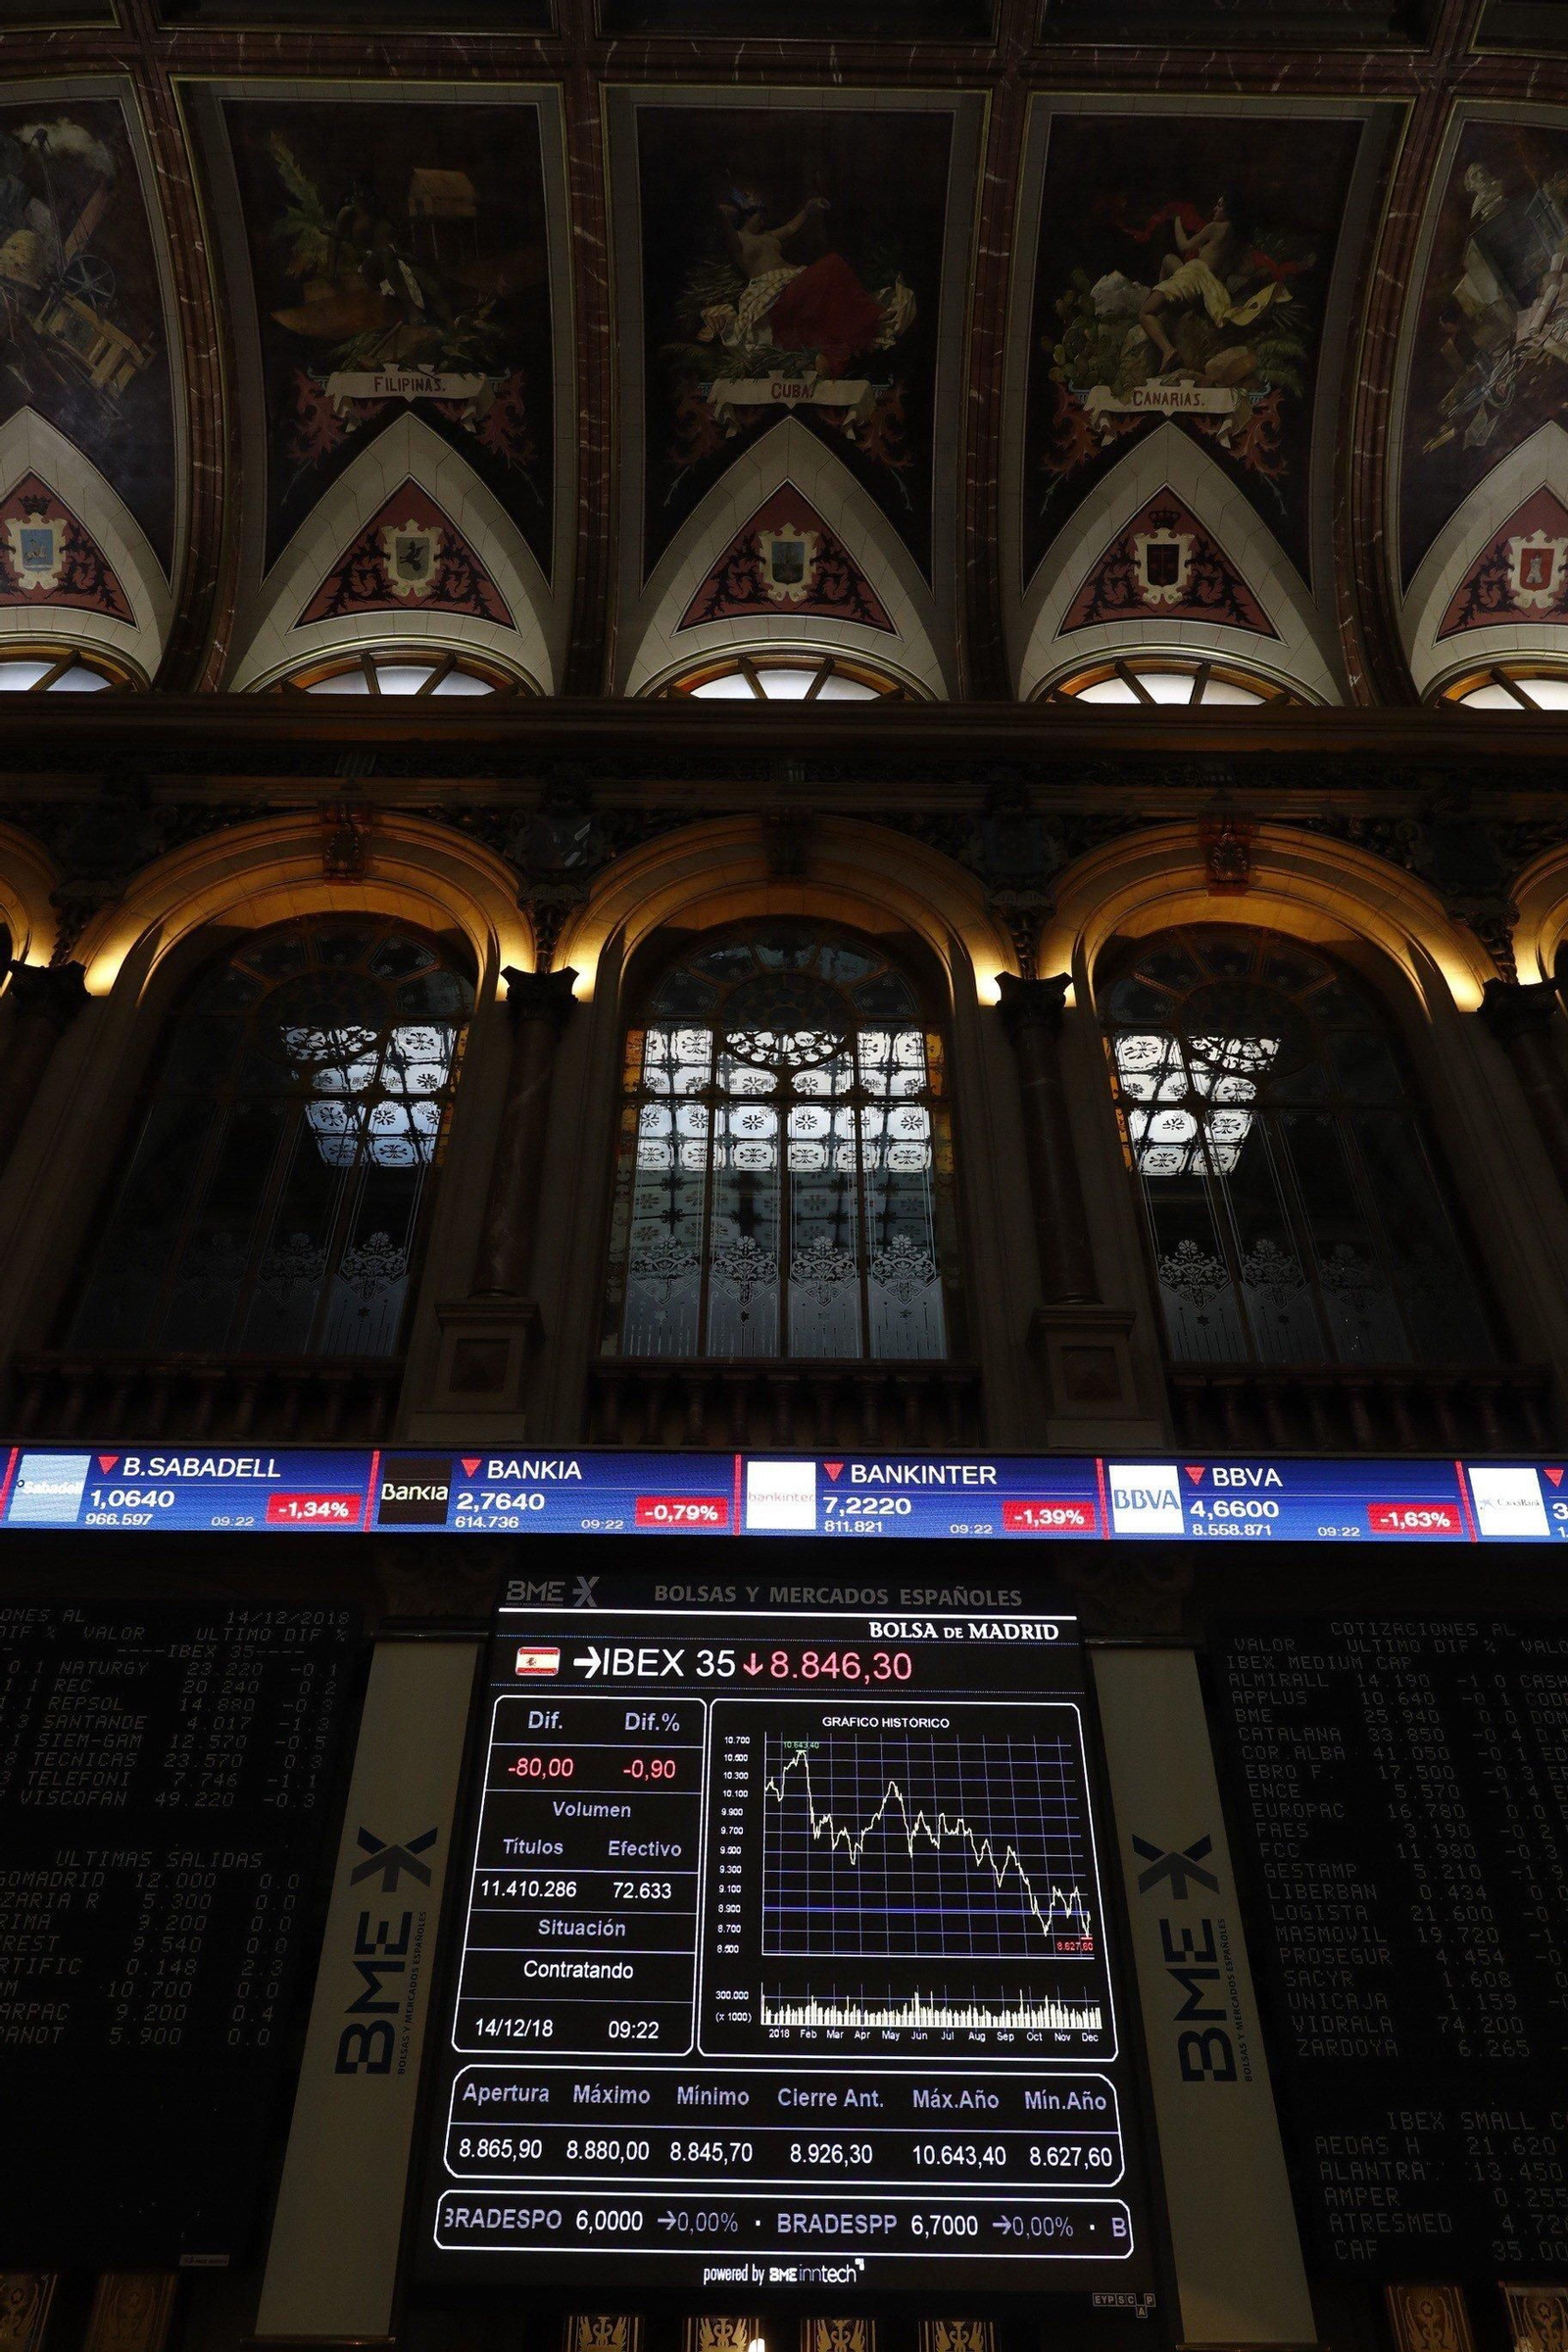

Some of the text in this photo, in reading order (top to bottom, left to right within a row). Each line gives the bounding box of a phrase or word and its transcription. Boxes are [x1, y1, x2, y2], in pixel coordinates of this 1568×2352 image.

[1132, 390, 1205, 407] CANARIAS.
[122, 1457, 280, 1477] B.SABADELL
[488, 1460, 582, 1479] BANKIA
[852, 1465, 997, 1484] BANKINTER
[1212, 1468, 1283, 1487] BBVA
[91, 1490, 174, 1509] 1,0640
[379, 1484, 450, 1503] Bankia
[457, 1493, 545, 1512] 2,7640
[1113, 1489, 1180, 1510] BBVA
[279, 1502, 349, 1519] -1,34%
[645, 1505, 718, 1523] -0,79%
[823, 1497, 913, 1519] 7,2220
[1190, 1500, 1279, 1520] 4,6600
[85, 1513, 153, 1529] 966.597
[210, 1517, 254, 1530] 09:22
[456, 1516, 519, 1532] 614.736
[578, 1516, 625, 1533] 09:22
[1014, 1509, 1085, 1527] -1,39%
[1381, 1512, 1450, 1532] -1,63%
[824, 1520, 882, 1536] 811.821
[947, 1525, 993, 1538] 09:22
[1193, 1524, 1271, 1540] 8.558.871
[1318, 1527, 1360, 1541] 09:22
[506, 1581, 565, 1601] BME
[654, 1584, 1023, 1607] BOLSAS Y MERCADOS ESPAÑOLES
[869, 1622, 939, 1642] BOLSA
[968, 1623, 1058, 1643] MADRID
[603, 1648, 911, 1685] IBEX 35 8.846,30
[528, 1711, 563, 1729] Dif.
[625, 1713, 679, 1731] Dif.%
[509, 1758, 573, 1779] -80,00
[623, 1760, 675, 1781] -0,90
[554, 1801, 630, 1817] Volumen
[504, 1838, 563, 1854] Títulos
[609, 1840, 681, 1856] Efectivo
[720, 1865, 741, 1874] 9.300
[482, 1881, 576, 1897] 11.410.286
[613, 1883, 671, 1898] 72.633
[719, 1885, 741, 1893] 9.100
[538, 1919, 625, 1936] Situación
[524, 1960, 633, 1979] Contratando
[716, 1990, 749, 1999] 300.000
[476, 2019, 553, 2036] 14/12/18
[609, 2021, 659, 2038] 09:22
[769, 2027, 789, 2037] 2018
[801, 2029, 816, 2038] Feb
[827, 2029, 844, 2038] Mar
[855, 2029, 870, 2040] Apr
[882, 2027, 900, 2041] May
[911, 2029, 927, 2039] Jun
[941, 2030, 954, 2040] Jul
[997, 2029, 1014, 2041] Sep
[1027, 2031, 1043, 2041] Oct
[1054, 2029, 1070, 2041] Nov
[1082, 2031, 1099, 2041] Dec
[968, 2032, 985, 2042] Aug
[463, 2083, 549, 2106] Apertura
[573, 2083, 650, 2103] Máximo
[677, 2085, 749, 2105] Mínimo
[778, 2088, 883, 2107] Cierre Ant.
[913, 2088, 999, 2108] Máx.Año
[460, 2138, 542, 2161] 8.865,90
[566, 2140, 649, 2163] 8.880,00
[670, 2142, 752, 2165] 8.845,70
[791, 2144, 872, 2167] 8.926,30
[913, 2145, 1005, 2169] 10.643,40
[1030, 2147, 1112, 2170] 8.627,60
[576, 2210, 643, 2233] 6,0000
[677, 2212, 738, 2235] 0,00%
[778, 2214, 1127, 2239] BRADESPP 6,7000 0,00% B
[704, 2264, 748, 2285] powered
[752, 2263, 765, 2287] by
